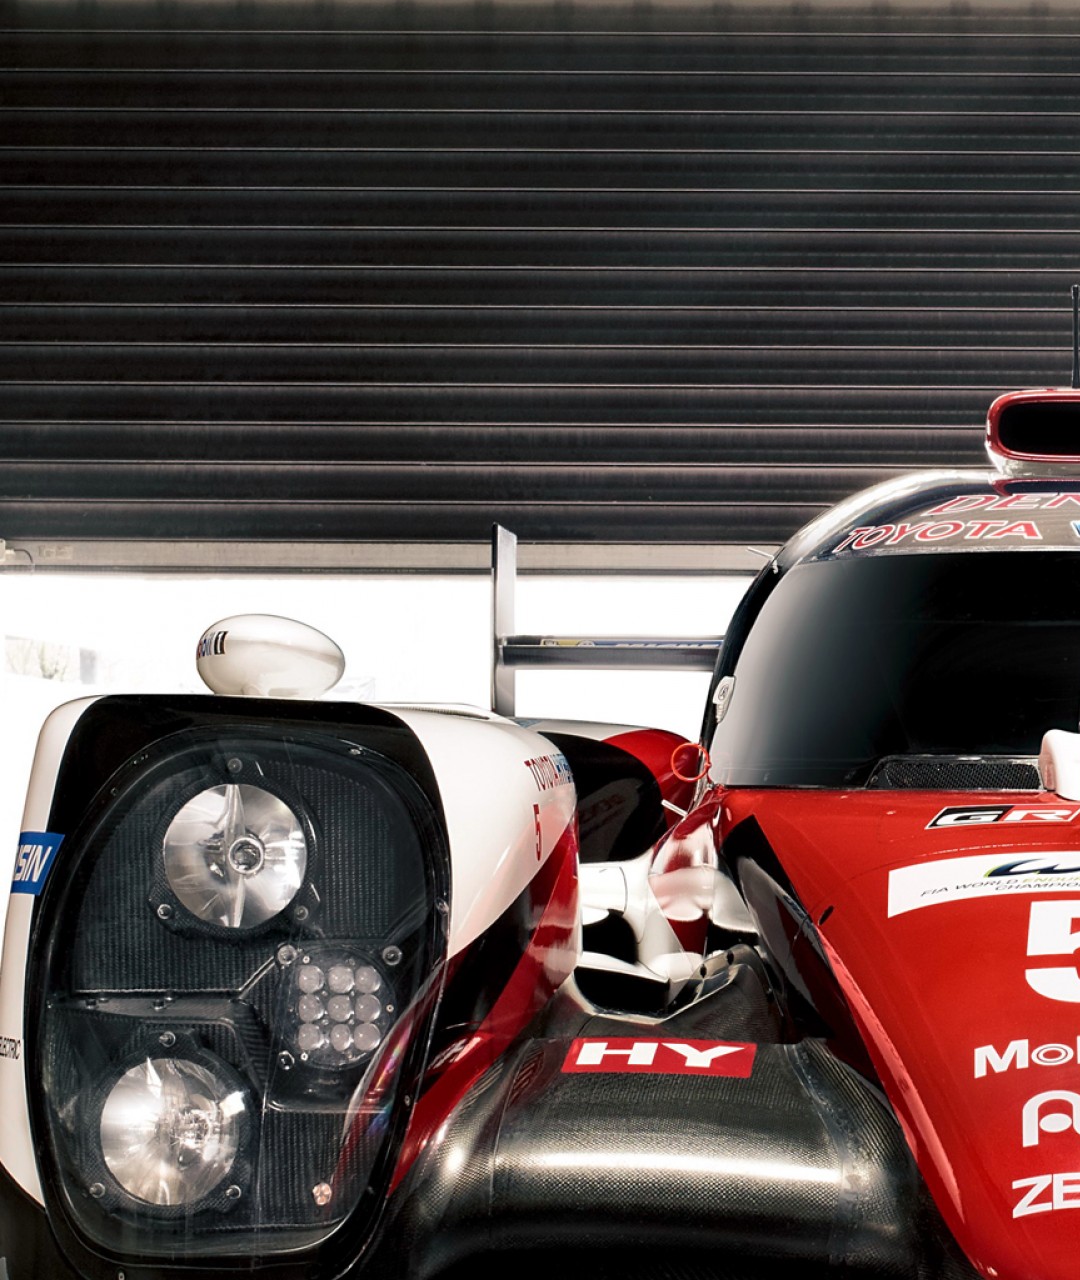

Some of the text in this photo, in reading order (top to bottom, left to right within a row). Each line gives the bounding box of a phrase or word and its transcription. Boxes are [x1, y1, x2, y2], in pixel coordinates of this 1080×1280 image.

[832, 520, 1044, 554] TOYOTA
[533, 803, 542, 861] 5
[920, 887, 949, 898] FIA
[955, 878, 1019, 891] WORLD
[575, 1041, 745, 1068] HY
